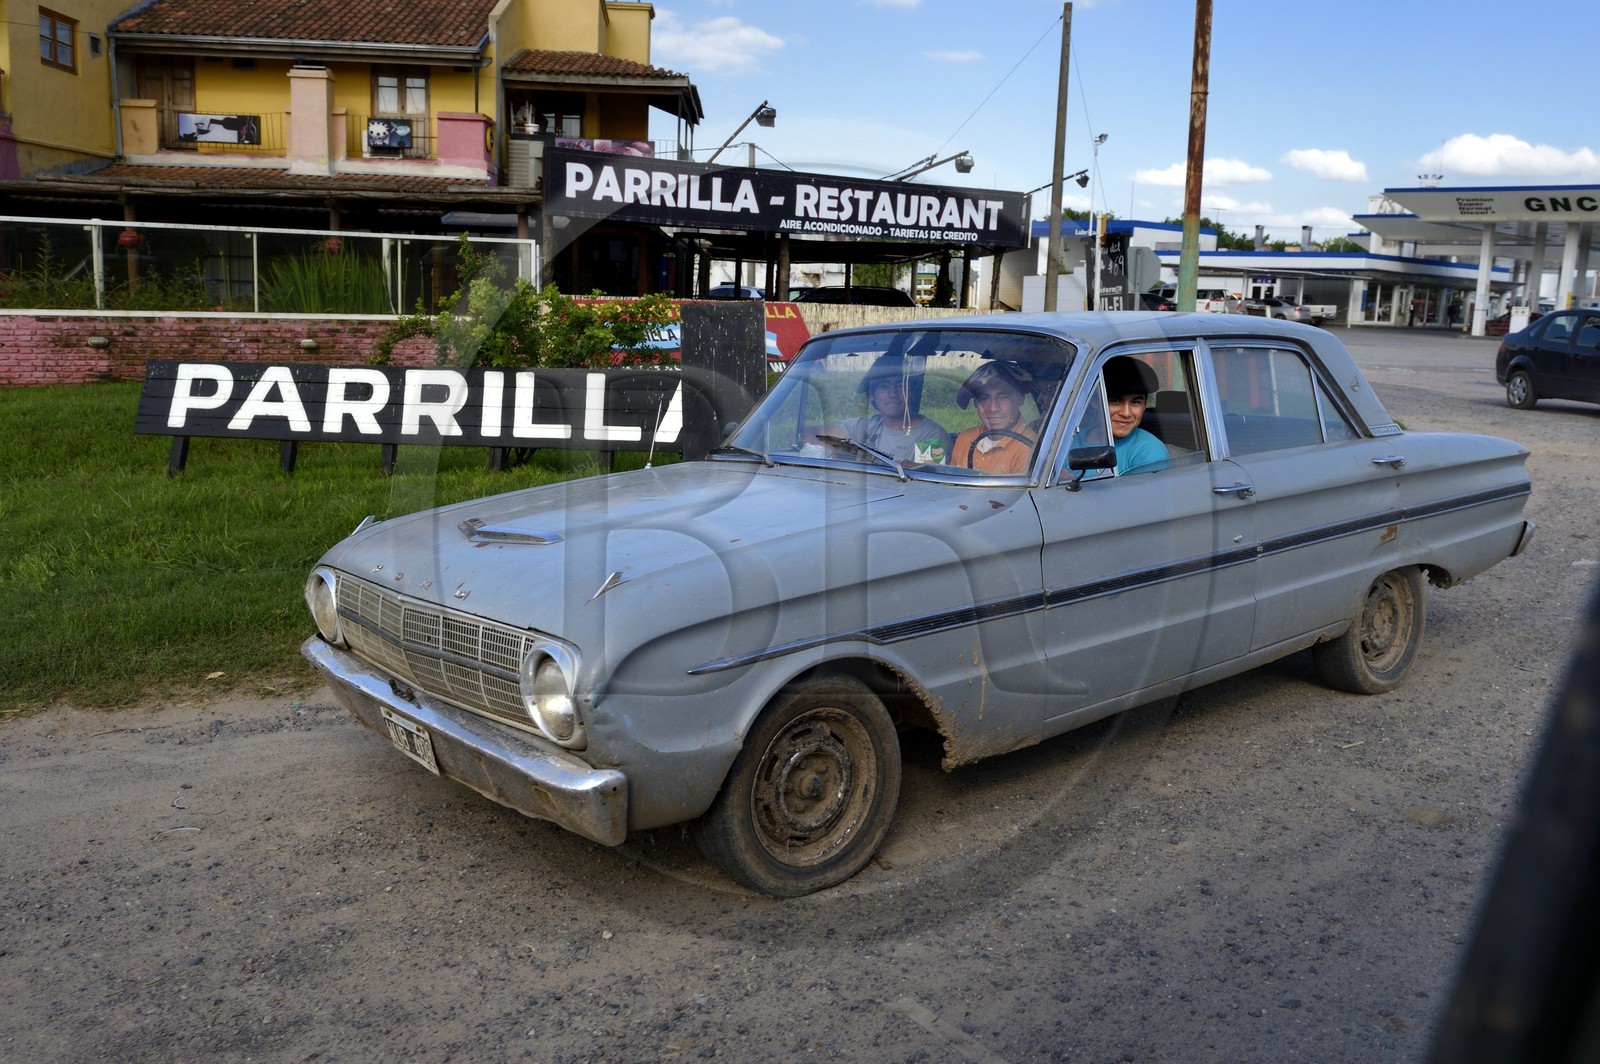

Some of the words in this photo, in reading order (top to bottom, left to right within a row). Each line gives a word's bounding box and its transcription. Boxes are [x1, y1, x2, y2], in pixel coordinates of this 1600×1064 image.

[565, 162, 760, 214] PARRILLA
[795, 184, 1004, 231] RESTAURANT
[1524, 197, 1599, 212] GNC
[779, 219, 802, 230] AIRE
[803, 221, 882, 236] ACONDICIONADO
[890, 227, 929, 239] TARJETAS
[930, 230, 942, 240] DE
[943, 232, 979, 242] CREDITO
